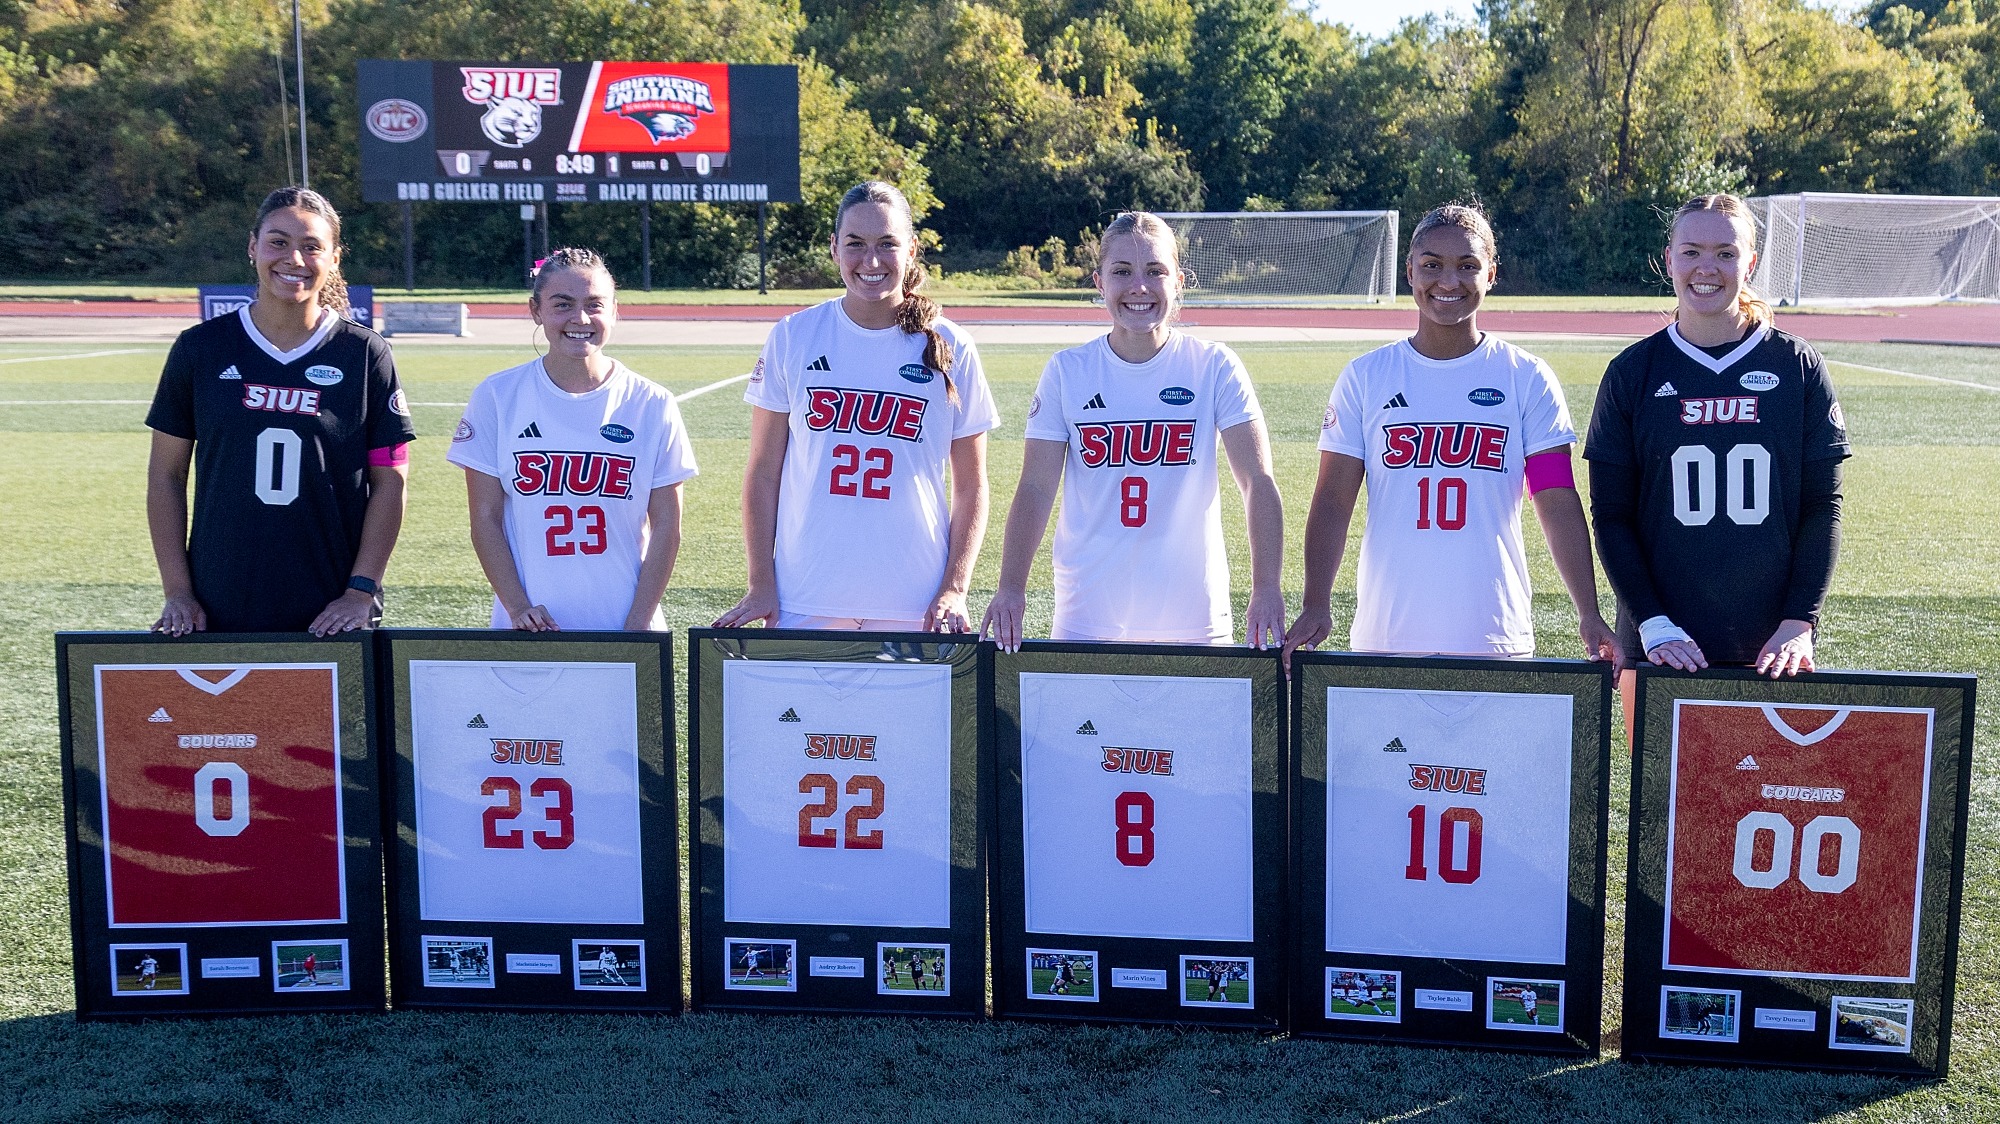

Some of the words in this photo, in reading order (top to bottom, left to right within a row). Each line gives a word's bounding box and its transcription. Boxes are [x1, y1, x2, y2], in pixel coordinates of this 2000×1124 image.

[463, 69, 559, 102] SIUE
[604, 87, 714, 110] INDIANA
[608, 77, 710, 95] SOUTHERN
[379, 112, 414, 129] OVC
[455, 152, 471, 175] 0
[556, 154, 595, 174] 8:49
[608, 156, 618, 173] 1
[696, 153, 711, 175] 0
[397, 183, 430, 200] BOB
[434, 183, 499, 200] GUELKER
[504, 183, 544, 200] FIELD
[599, 184, 647, 200] RALPH
[652, 184, 697, 200] KORTE
[703, 184, 768, 200] STADIUM
[242, 384, 321, 416] SIUE
[805, 386, 929, 442] SIUE
[1680, 396, 1758, 425] SIUE
[1074, 419, 1197, 468] SIUE
[1381, 421, 1509, 473] SIUE
[255, 427, 302, 506] 0
[512, 450, 636, 499] SIUE
[829, 443, 894, 500] 22
[1671, 443, 1771, 526] 00
[1120, 476, 1149, 528] 8
[1416, 476, 1468, 531] 10
[544, 505, 608, 556] 23
[177, 734, 258, 748] COUGARS
[489, 738, 563, 765] SIUE
[804, 733, 877, 761] SIUE
[1100, 746, 1174, 776] SIUE
[1408, 764, 1487, 795] SIUE
[1761, 784, 1845, 802] COUGARS
[194, 762, 250, 837] 0
[480, 776, 575, 849] 23
[798, 773, 885, 849] 22
[1115, 791, 1155, 867] 8
[1405, 804, 1483, 884] 10
[1733, 810, 1861, 894] 00
